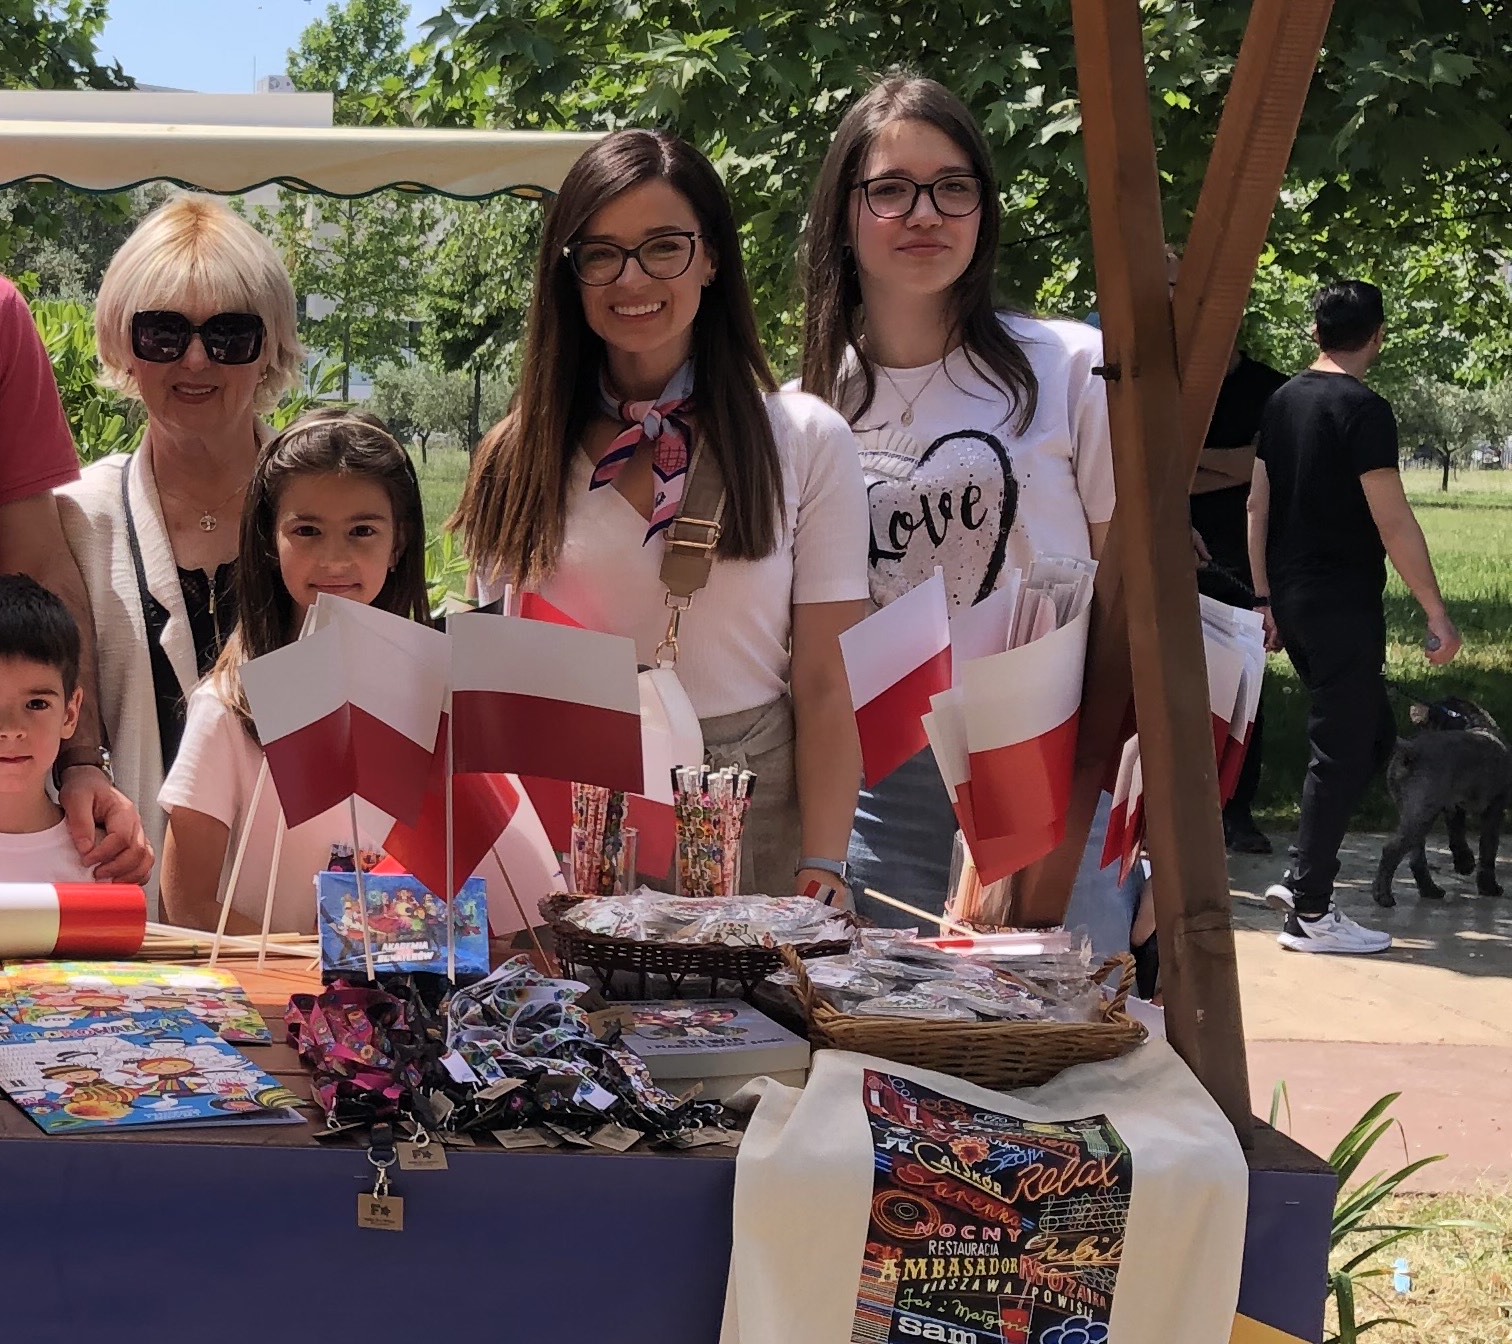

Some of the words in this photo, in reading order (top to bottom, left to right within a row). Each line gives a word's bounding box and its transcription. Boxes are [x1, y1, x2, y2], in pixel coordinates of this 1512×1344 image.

[1011, 1150, 1123, 1203] Relax
[915, 1221, 1022, 1243] NOCNY
[878, 1257, 1018, 1282] AMBASADOR
